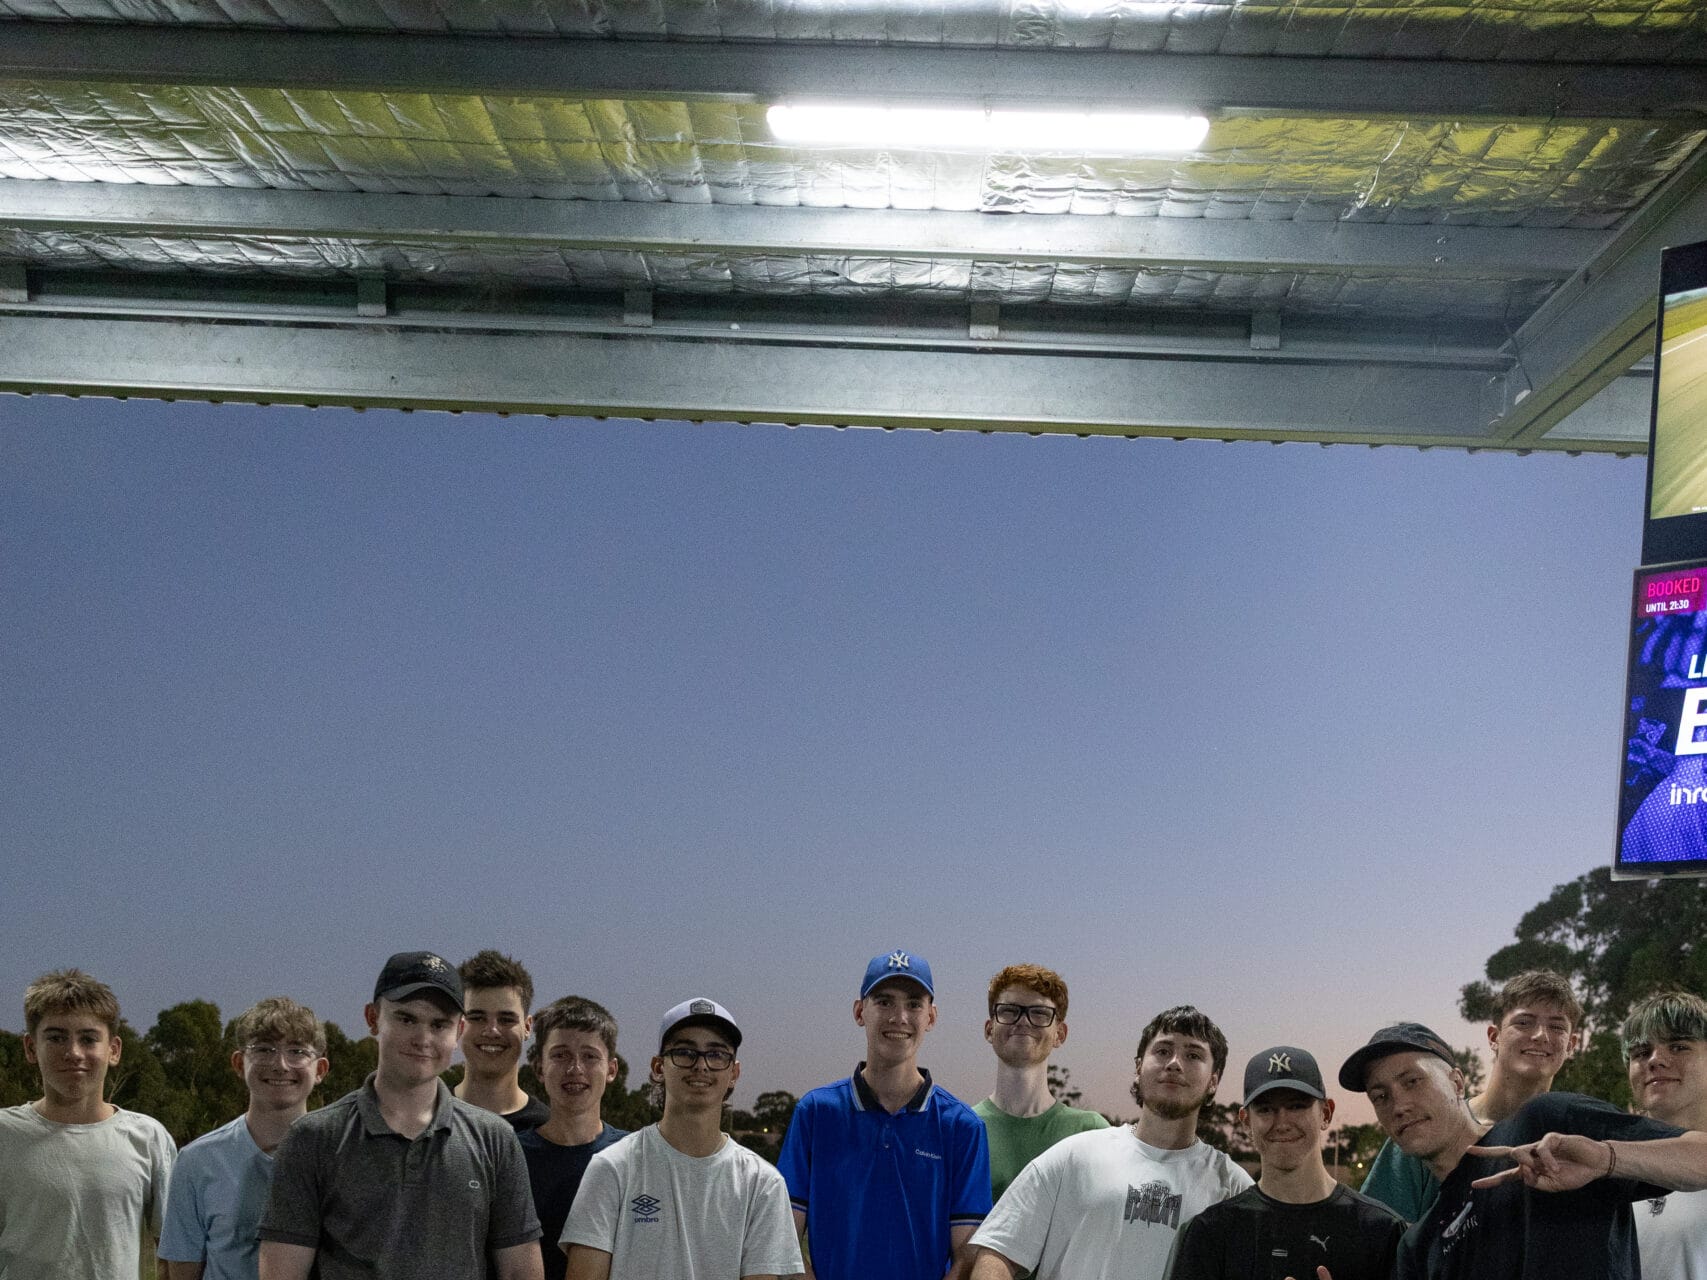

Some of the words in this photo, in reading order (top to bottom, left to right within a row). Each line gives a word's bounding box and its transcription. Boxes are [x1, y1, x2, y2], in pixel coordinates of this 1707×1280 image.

[1647, 577, 1701, 598] BOOKED
[1645, 602, 1668, 613] UNTIL
[1669, 599, 1690, 611] 21:30
[633, 1215, 660, 1223] umbro
